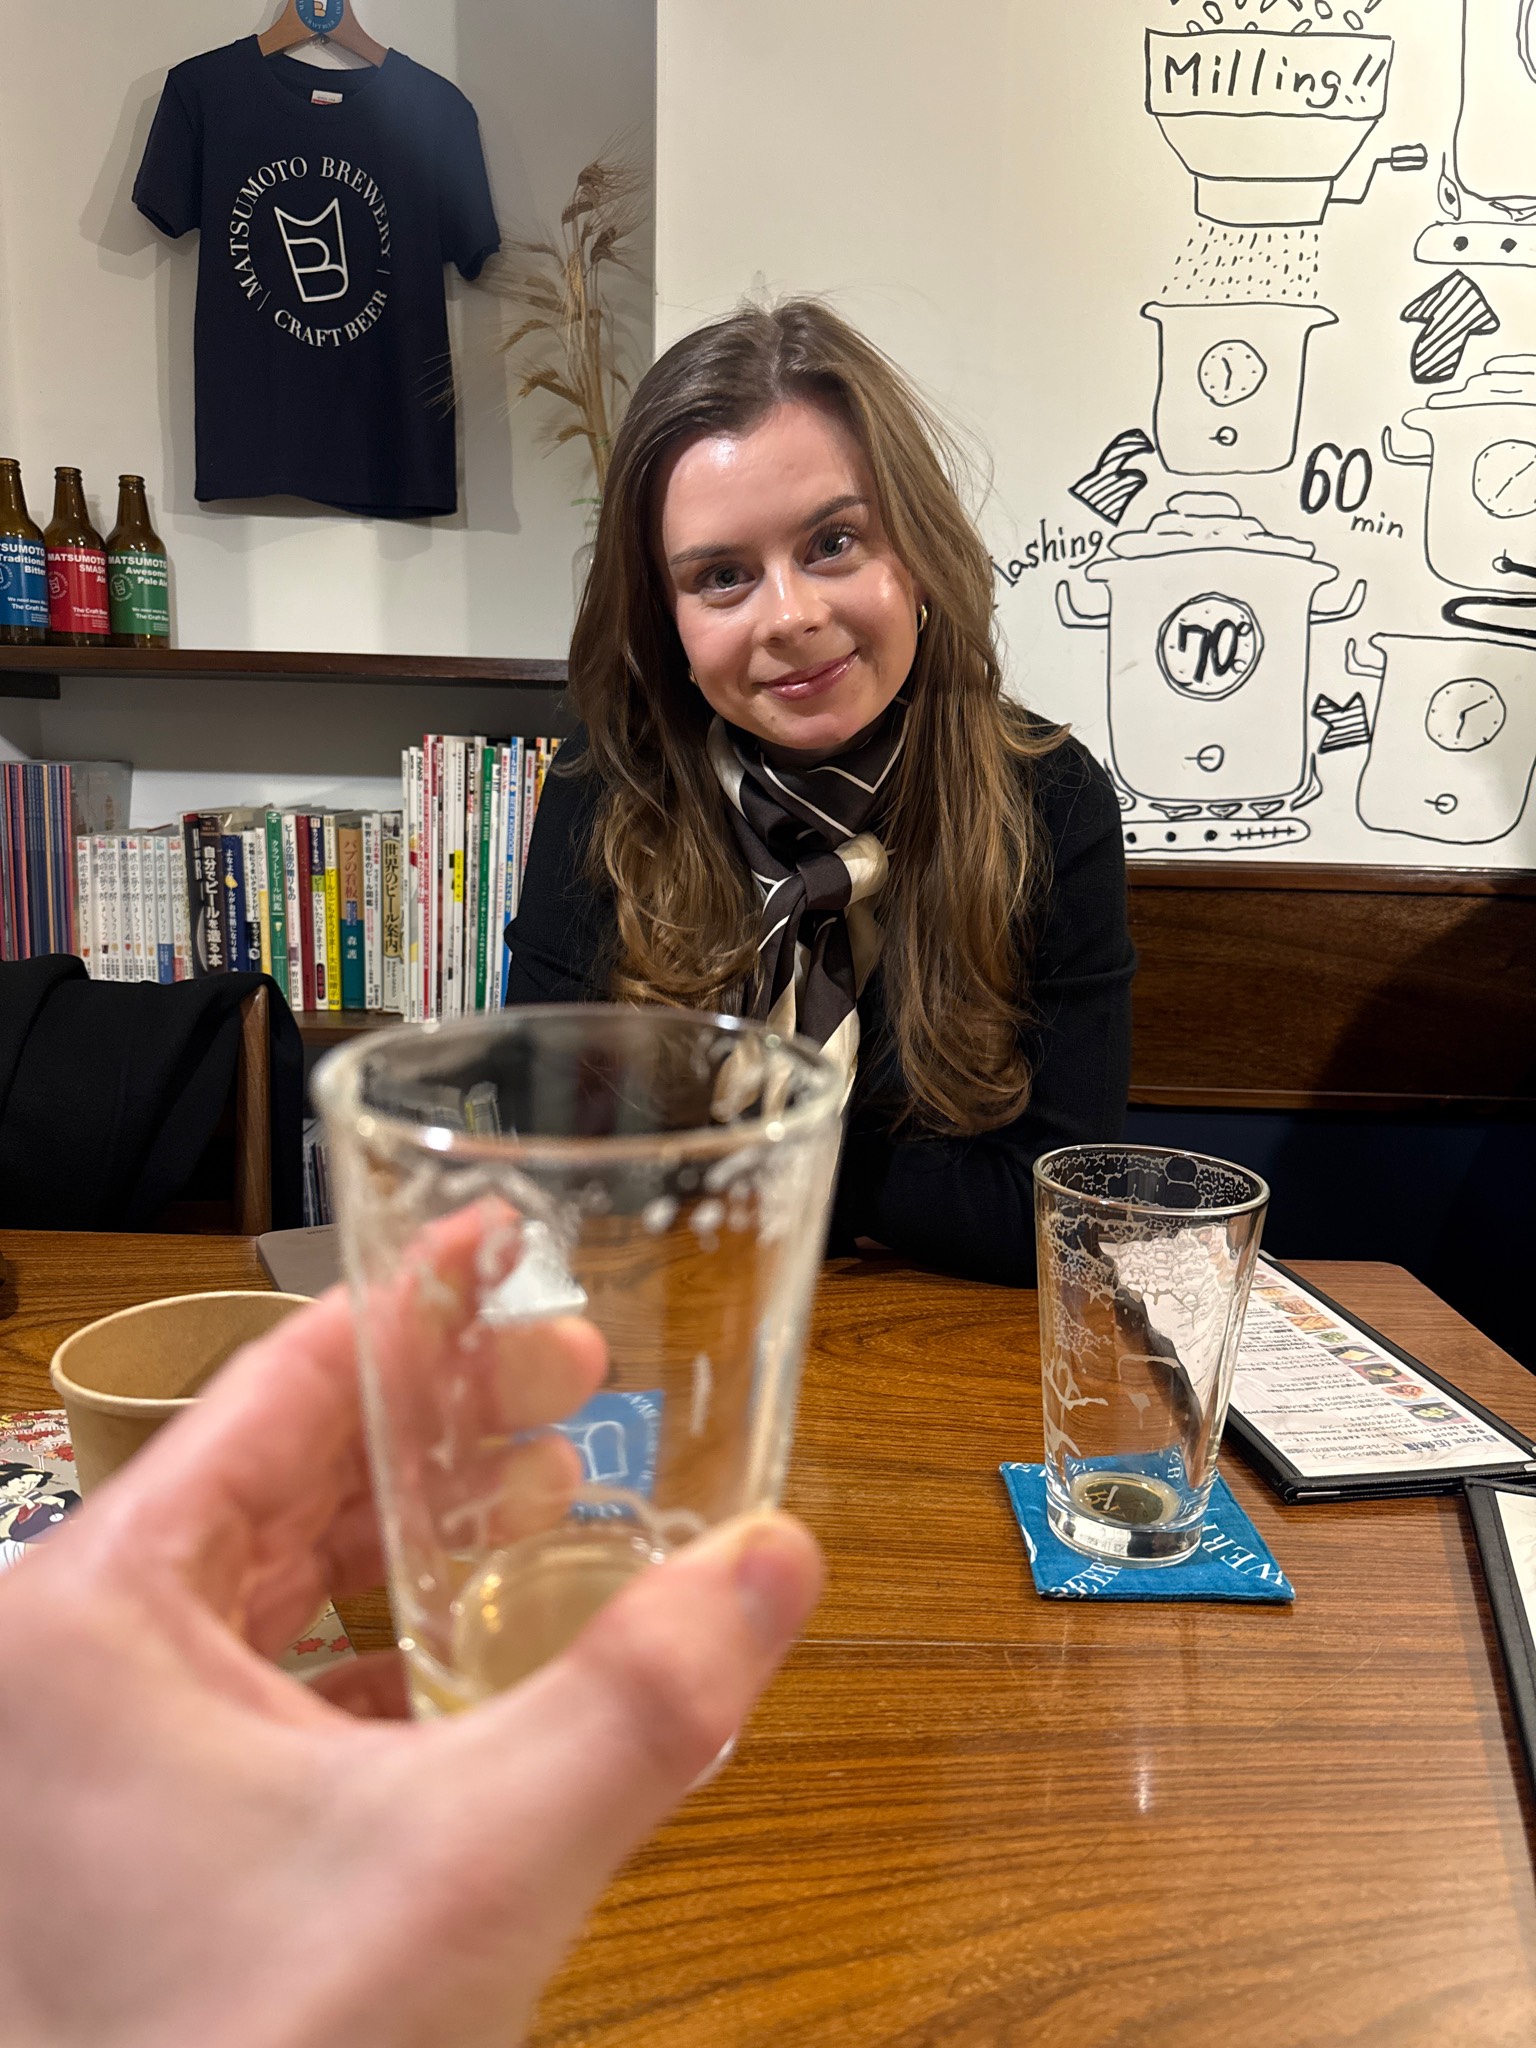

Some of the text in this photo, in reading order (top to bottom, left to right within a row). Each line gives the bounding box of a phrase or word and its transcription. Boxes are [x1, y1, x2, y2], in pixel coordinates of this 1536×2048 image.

[1165, 47, 1387, 109] Milling!!
[229, 156, 391, 300] MATSUMOTO BREWERY
[274, 290, 388, 348] CRAFT BEER
[1300, 442, 1404, 539] 60 min
[0, 543, 45, 556] SUMOTO
[48, 553, 105, 566] MATSUMOTO
[108, 556, 167, 569] MATSUMOTO
[137, 576, 158, 585] Pale
[365, 822, 373, 907] 世界と日本のビール図鑑
[203, 846, 223, 967] 自分でビールを造る本
[385, 843, 399, 954] 世界のビール案内
